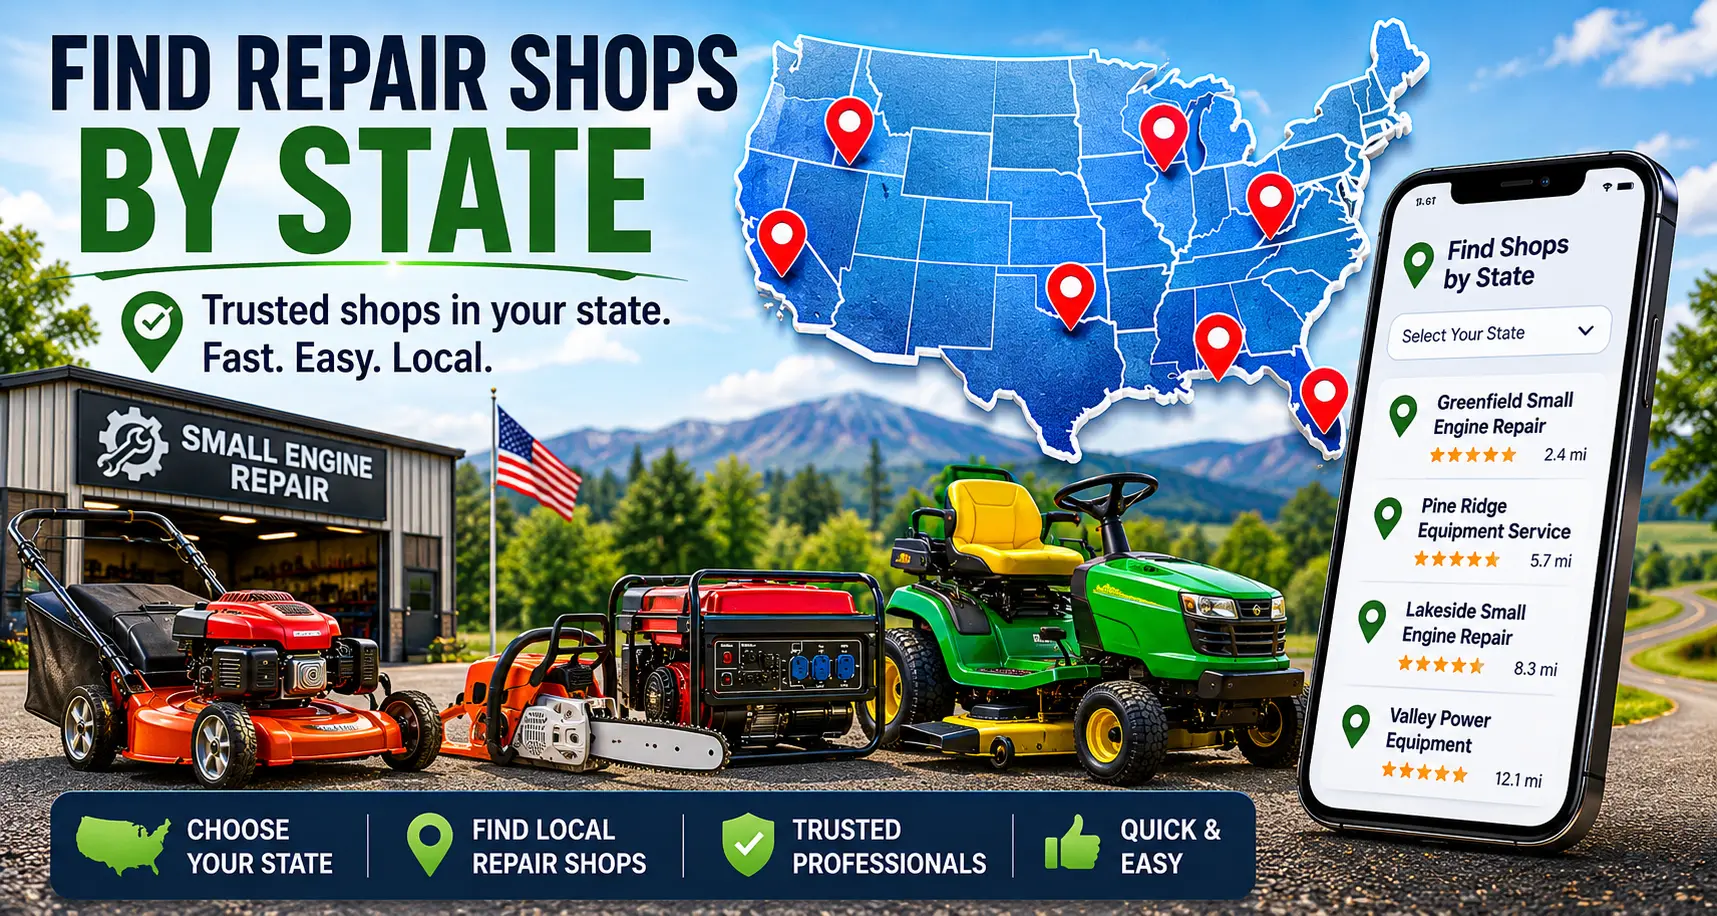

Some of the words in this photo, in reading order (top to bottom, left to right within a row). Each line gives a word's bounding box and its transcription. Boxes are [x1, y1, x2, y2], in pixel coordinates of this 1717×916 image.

[1447, 237, 1495, 261] Find
[1499, 235, 1570, 260] Shops
[1443, 268, 1471, 294] by
[1475, 266, 1535, 288] State
[1402, 328, 1447, 344] Select
[1451, 327, 1484, 342] Your
[1486, 325, 1525, 341] State
[1437, 392, 1523, 411] Greenfield
[1526, 391, 1574, 409] Small
[1433, 418, 1489, 439] Engine
[1492, 416, 1547, 438] Repair
[181, 424, 277, 464] SMALL
[285, 443, 373, 480] ENGINE
[1544, 447, 1566, 462] 2.4
[1569, 447, 1588, 461] mi
[231, 464, 330, 503] REPAIR
[1421, 497, 1457, 514] Pine
[1460, 497, 1508, 517] Ridge
[1417, 521, 1505, 542] Equipment
[1507, 522, 1572, 540] Service
[1530, 553, 1552, 568] 5.7
[1554, 553, 1573, 568] mi
[1405, 601, 1477, 620] Lakeside
[1480, 603, 1527, 621] Small
[1402, 626, 1457, 647] Engine
[1460, 628, 1514, 649] Repair
[1514, 660, 1537, 676] 8.3
[1539, 662, 1558, 677] mi
[1390, 707, 1437, 729] Valley
[1439, 709, 1492, 729] Power
[1385, 731, 1473, 755] Equipment
[1495, 771, 1521, 787] 12.1
[1524, 773, 1543, 789] mi
